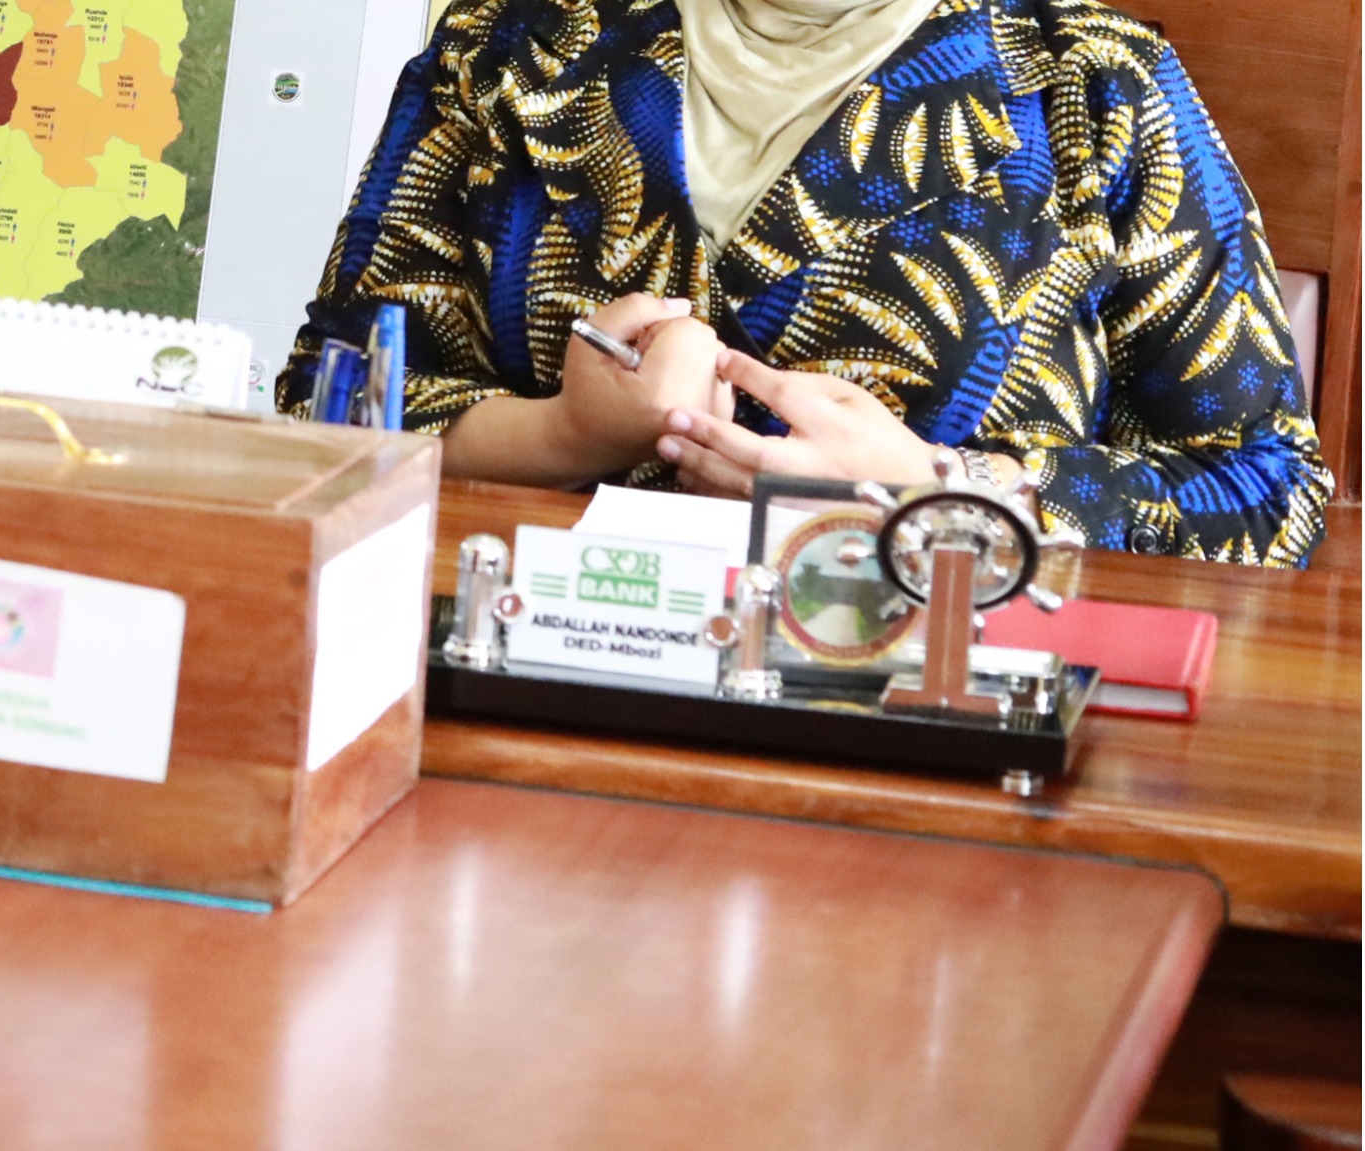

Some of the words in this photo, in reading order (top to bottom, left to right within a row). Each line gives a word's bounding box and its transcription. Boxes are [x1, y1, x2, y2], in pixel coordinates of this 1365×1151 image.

[580, 577, 657, 605] BANK
[531, 614, 609, 634] ABDALLAH
[614, 624, 699, 647] NANDONDE
